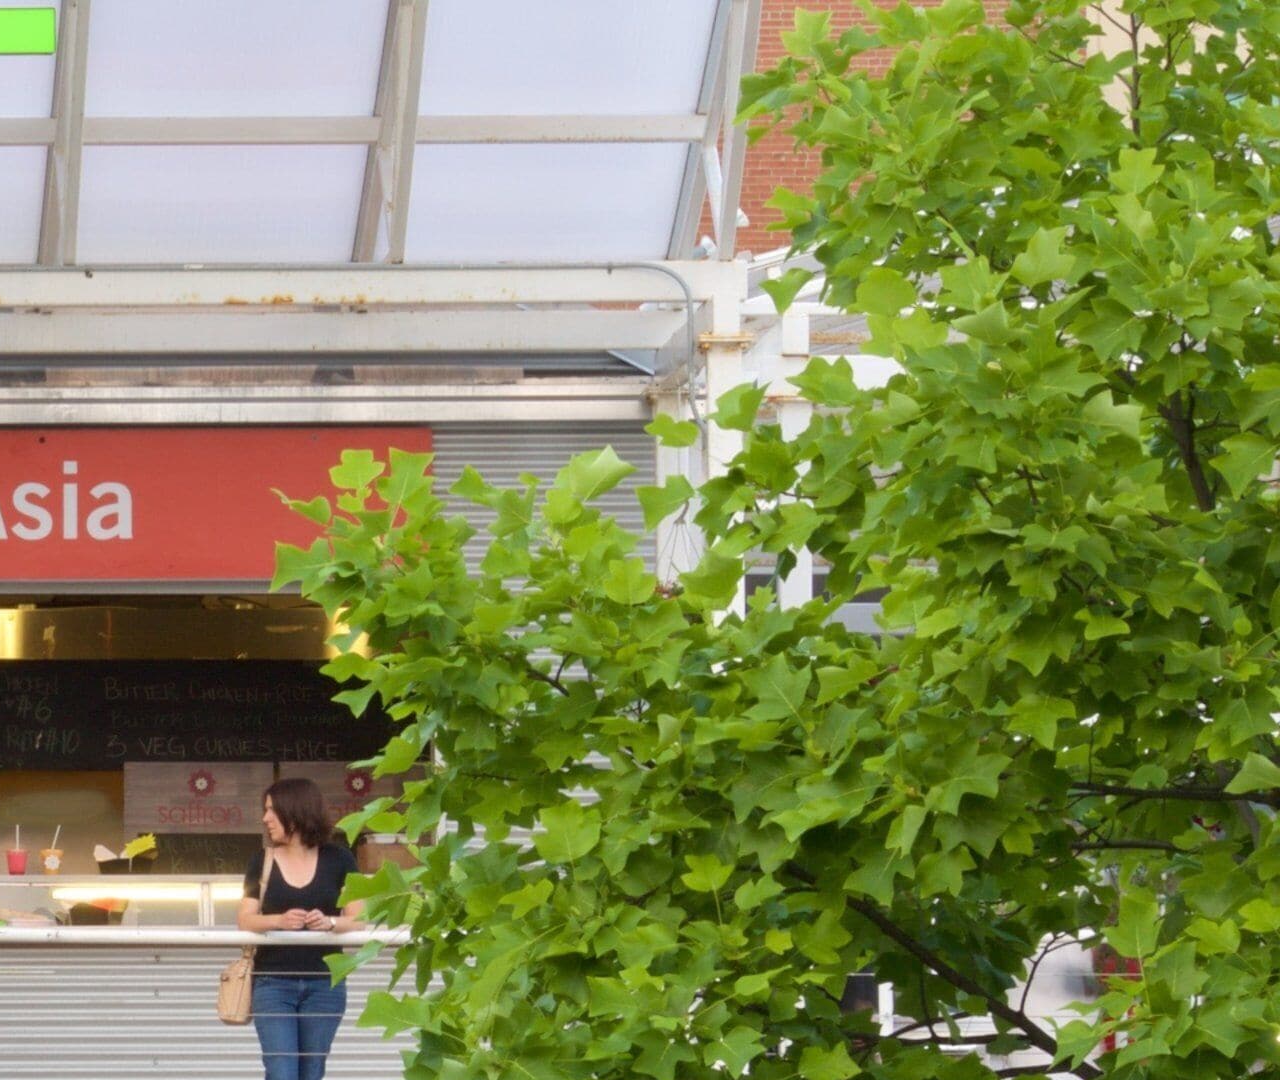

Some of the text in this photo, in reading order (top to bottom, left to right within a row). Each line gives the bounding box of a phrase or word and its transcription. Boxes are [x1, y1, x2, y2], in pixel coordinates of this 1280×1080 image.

[105, 733, 127, 758] 3
[137, 735, 187, 758] VEG
[193, 735, 274, 758] CURRIES
[296, 739, 339, 762] RICE
[157, 799, 244, 826] saffron
